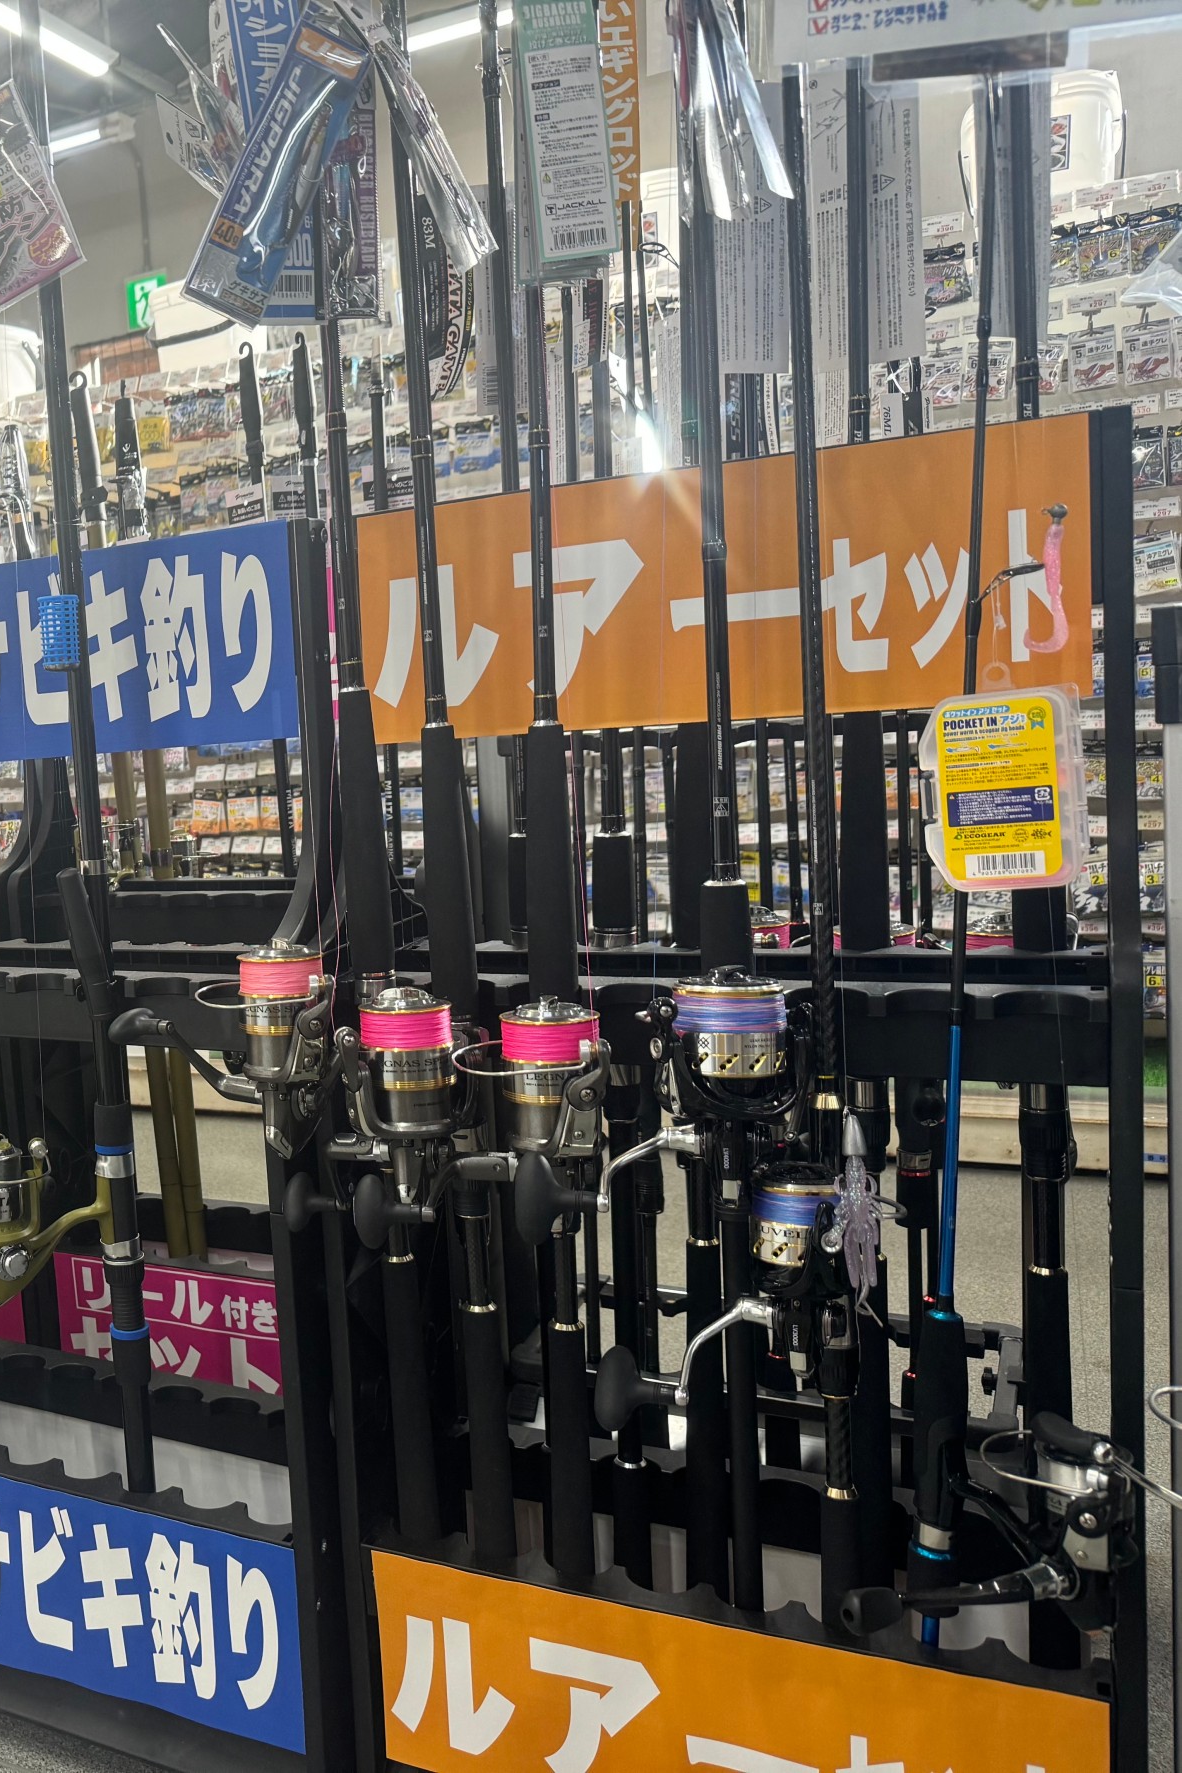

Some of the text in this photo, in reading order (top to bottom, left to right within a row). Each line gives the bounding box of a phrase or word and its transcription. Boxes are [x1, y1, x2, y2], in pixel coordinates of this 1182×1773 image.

[234, 64, 304, 214] JIGPARA
[557, 199, 606, 211] JACKALL
[214, 222, 240, 248] 40g
[421, 216, 436, 249] 83M
[1075, 349, 1083, 359] 5
[1129, 343, 1137, 352] 6
[436, 324, 461, 393] GAME
[883, 406, 892, 436] 76ML
[1134, 555, 1142, 565] 5
[372, 508, 1063, 709] ルアーセット
[1141, 667, 1150, 677] 5
[943, 713, 1021, 731] POCKET IN アジ
[384, 780, 393, 822] MILITA
[964, 831, 1006, 840] ECOGEAR
[1091, 875, 1100, 885] 2
[1147, 875, 1155, 885] 3
[1148, 977, 1157, 987] 6
[70, 1315, 281, 1395] セット
